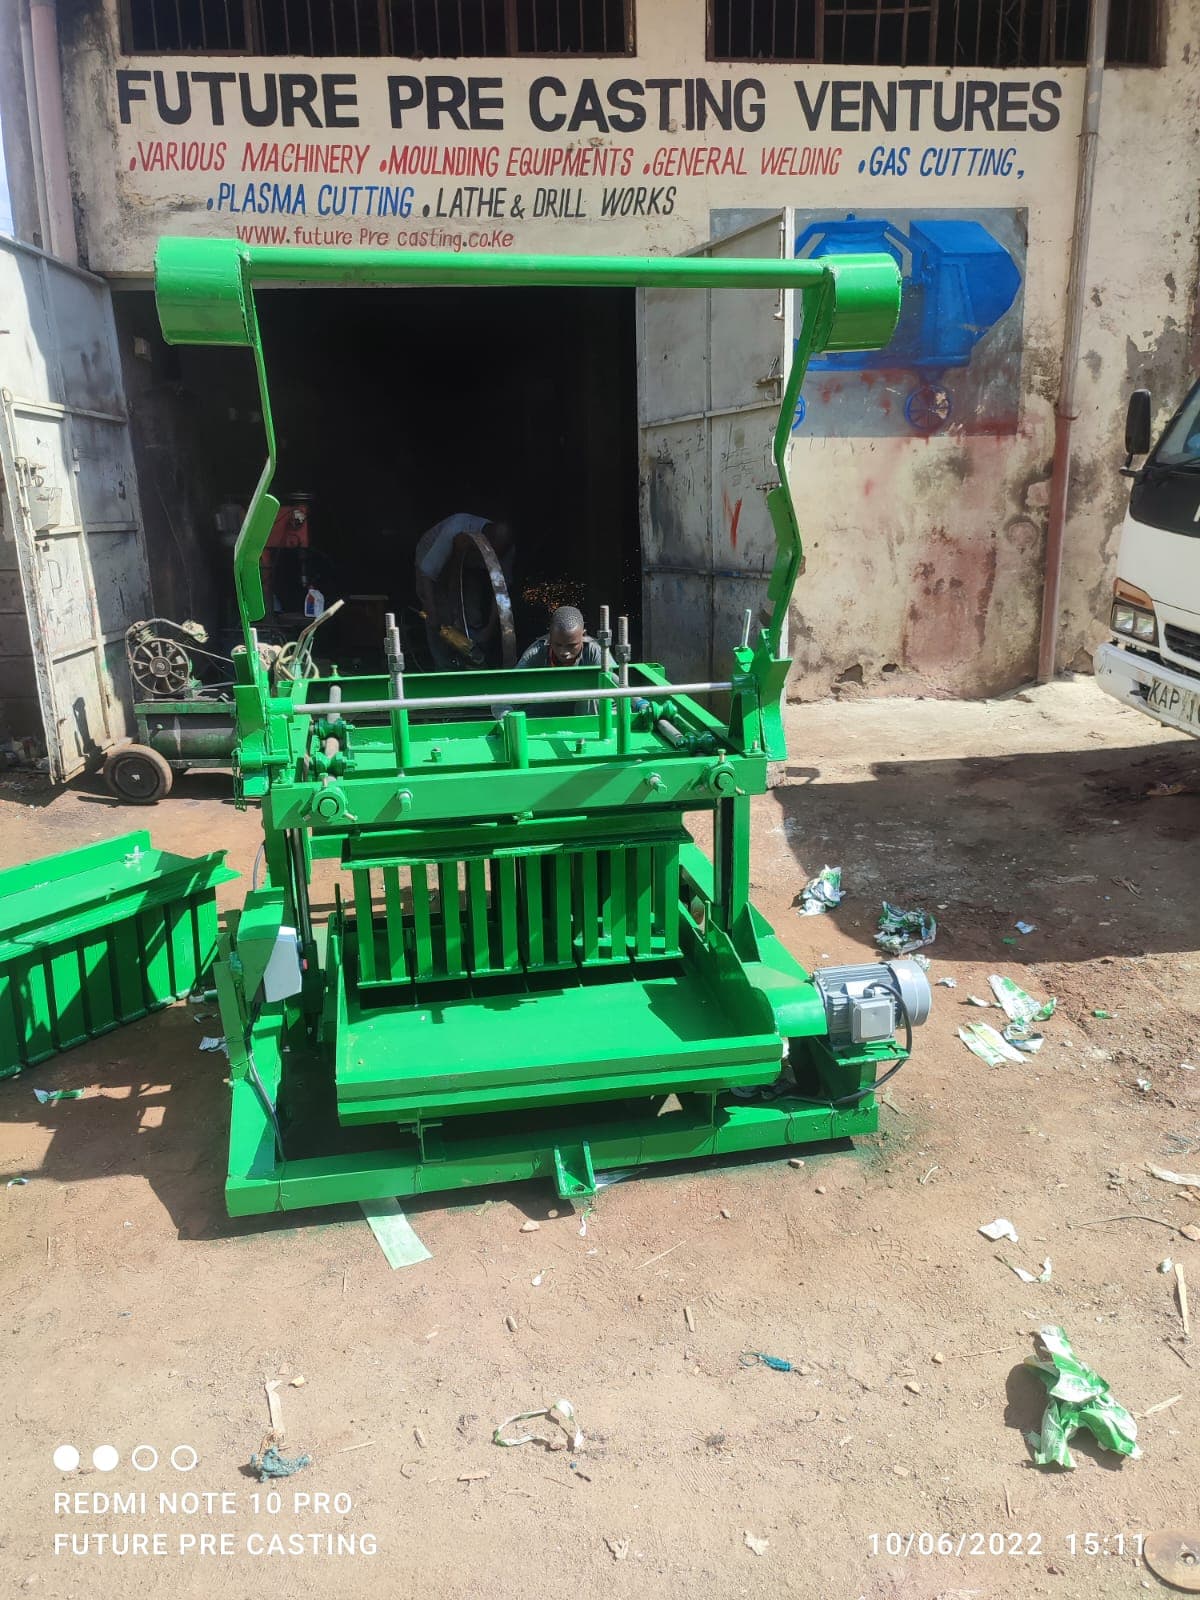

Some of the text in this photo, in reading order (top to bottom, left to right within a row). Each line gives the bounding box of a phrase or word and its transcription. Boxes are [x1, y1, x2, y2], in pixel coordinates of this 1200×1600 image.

[116, 70, 1063, 133] FUTURE PRE CASTING VENTURES
[138, 141, 227, 171] VARIOUS
[241, 142, 370, 174] MACHINERY
[388, 145, 500, 177] MOULNDING
[506, 147, 634, 177] EQUIPMENTS
[652, 147, 748, 177] GENERAL
[760, 147, 842, 176] WELDING
[869, 146, 910, 177] GAS
[218, 182, 677, 218] PLASMA CUTTING LATHE & DRILL WORKS
[359, 227, 389, 246] Pre
[1149, 680, 1180, 710] KAP
